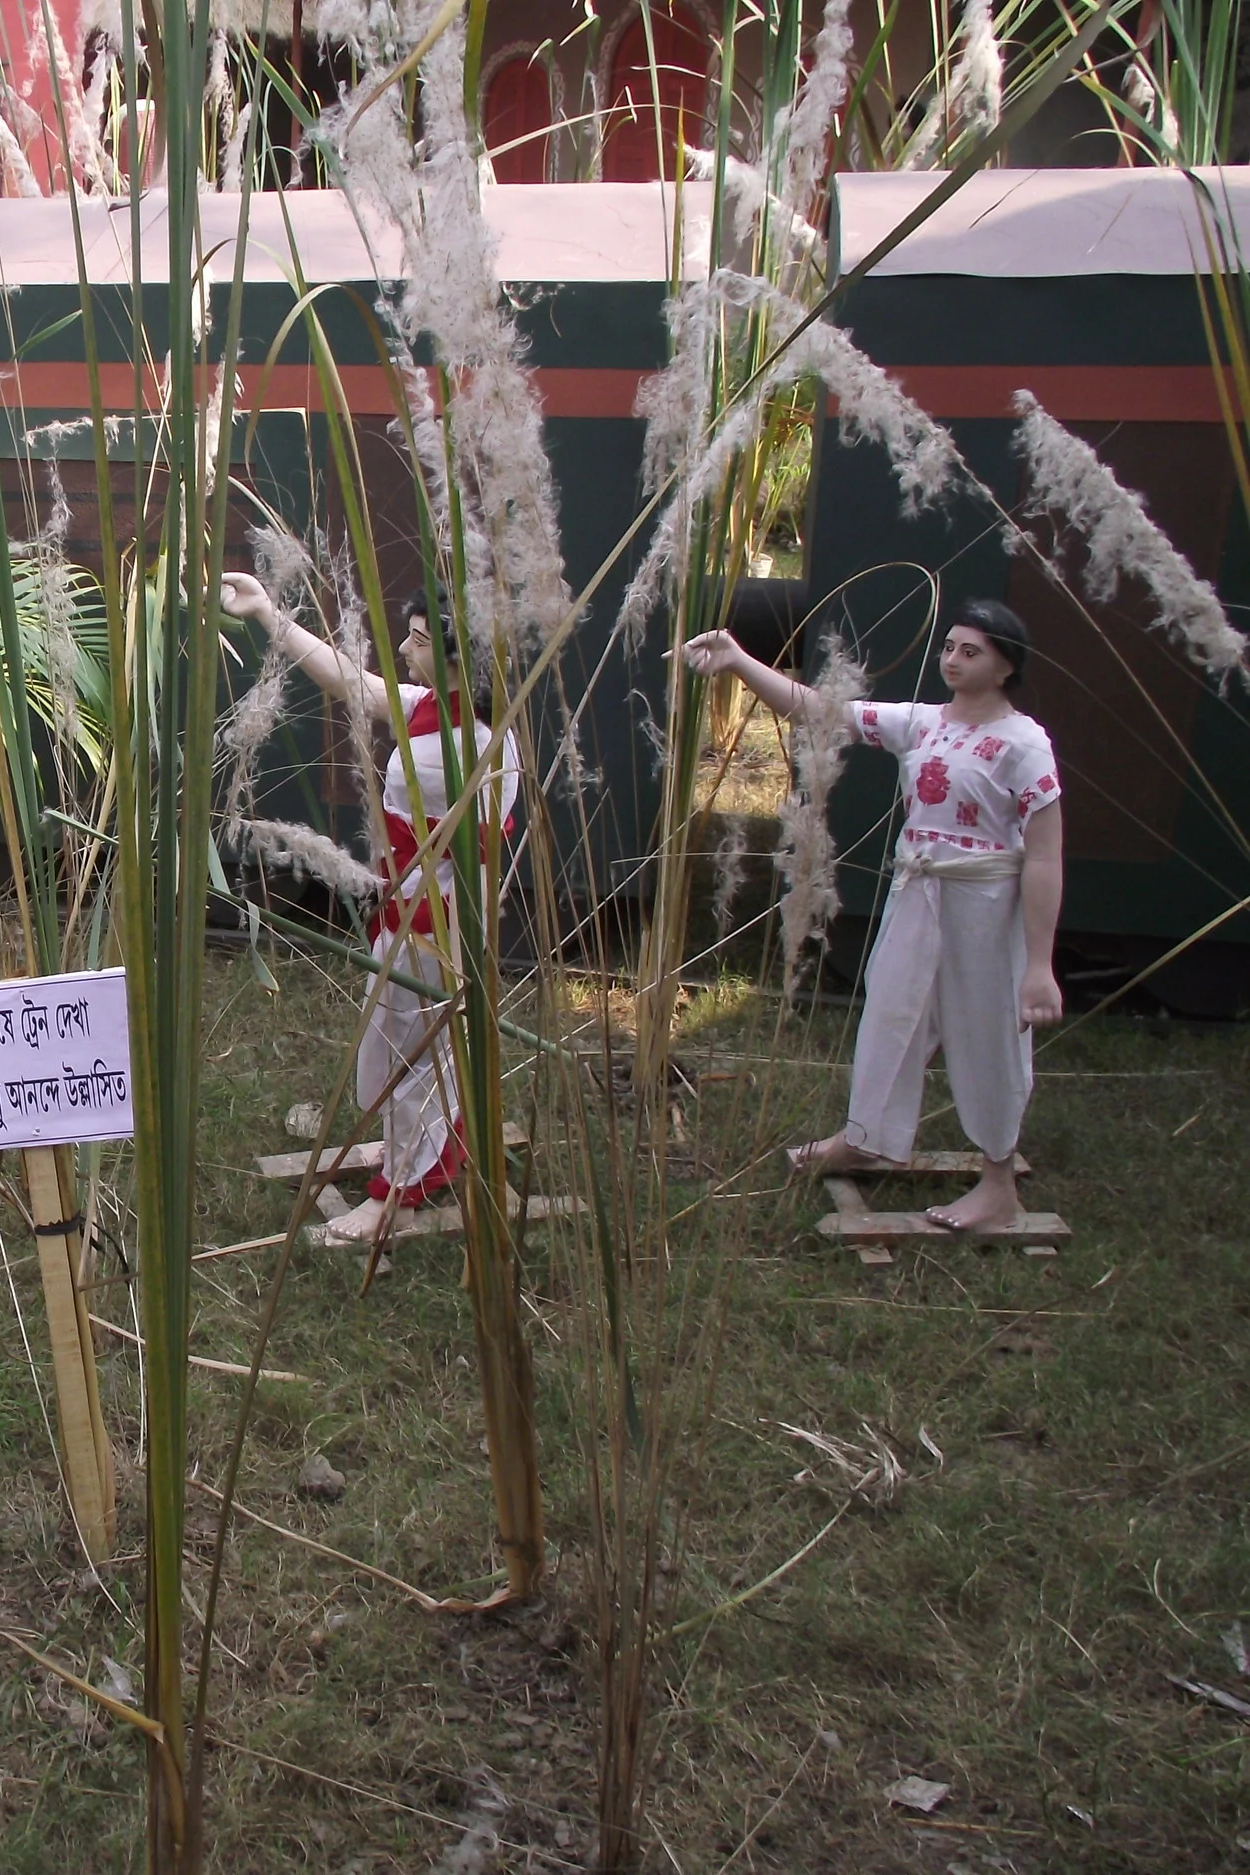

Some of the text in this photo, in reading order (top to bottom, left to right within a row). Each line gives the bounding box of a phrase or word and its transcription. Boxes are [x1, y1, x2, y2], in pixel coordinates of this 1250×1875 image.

[21, 994, 50, 1050] ট্রেন
[55, 997, 91, 1038] দেখা
[5, 1075, 61, 1117] আনন্দে
[62, 1058, 126, 1109] উল্লাসিত
